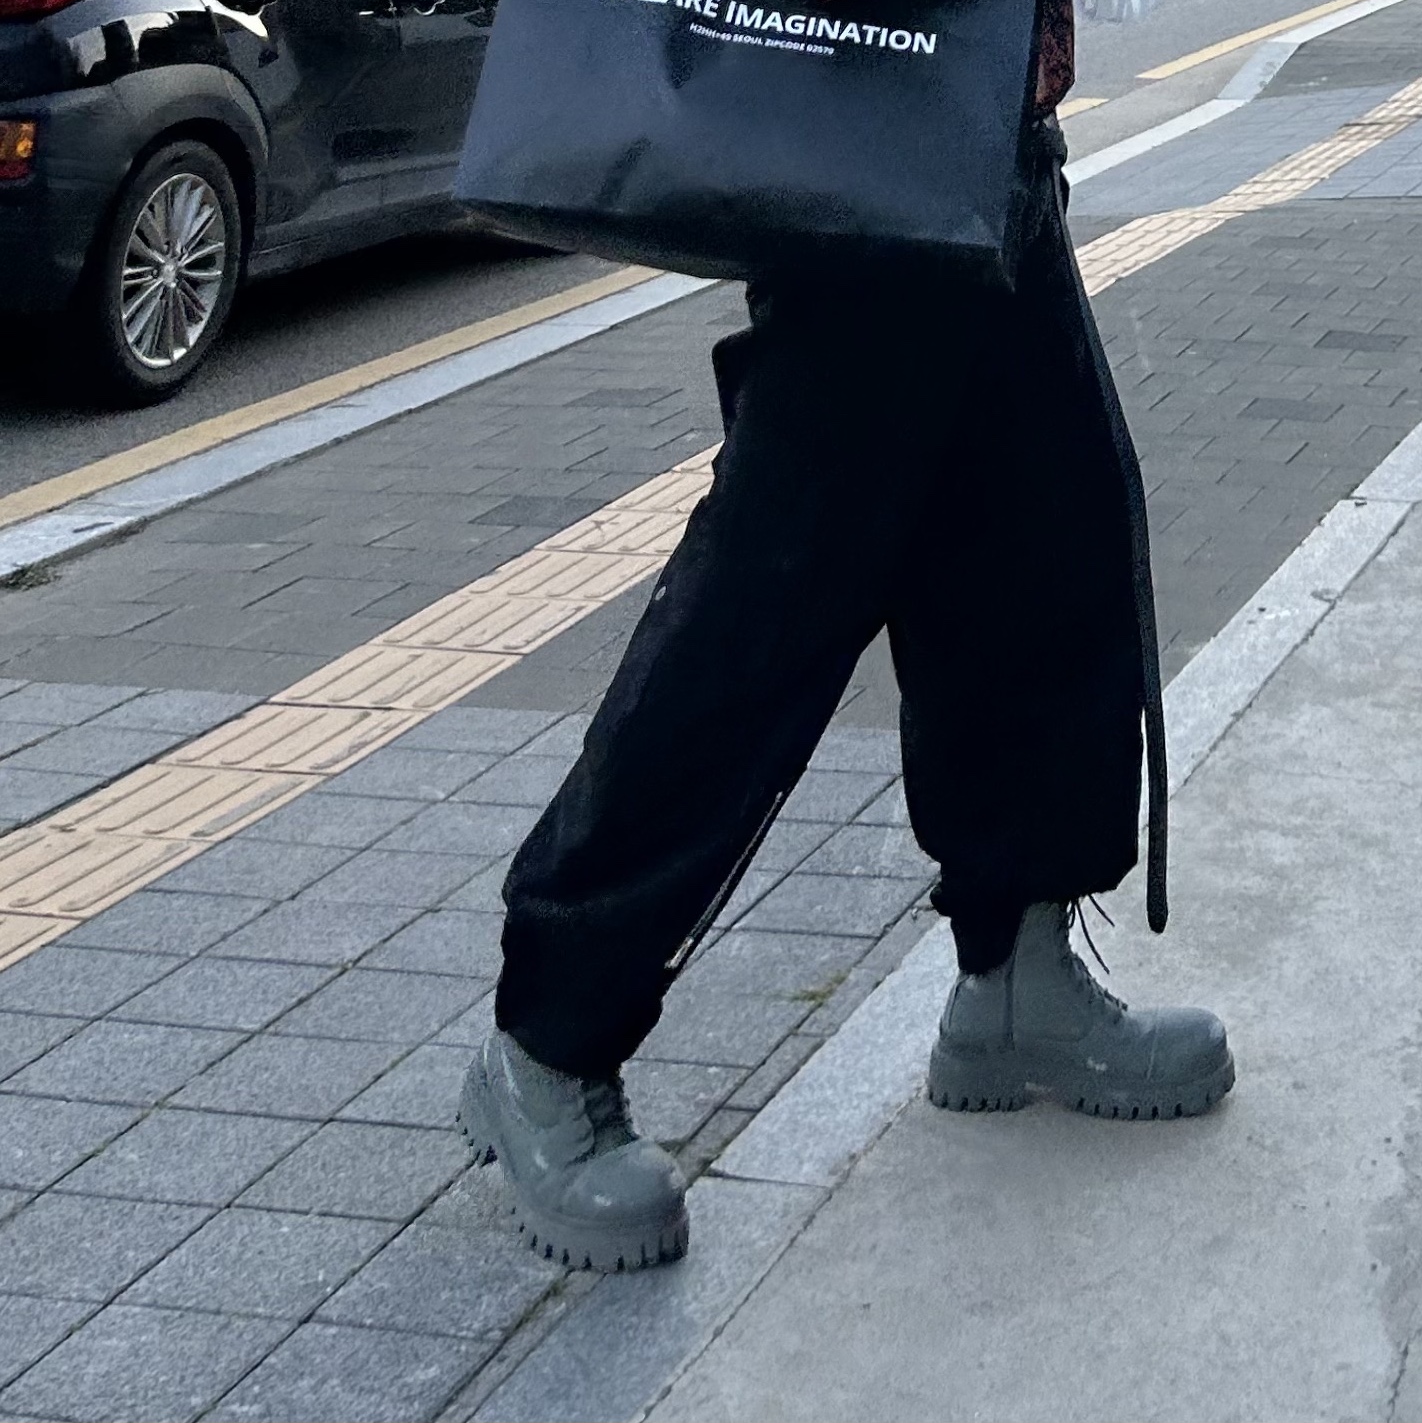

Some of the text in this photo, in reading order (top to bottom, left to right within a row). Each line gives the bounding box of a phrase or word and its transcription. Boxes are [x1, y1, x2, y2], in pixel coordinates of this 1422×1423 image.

[724, 0, 937, 54] IMAGINATION
[732, 33, 763, 46] SEOUL
[764, 38, 805, 51] ZIPCODE
